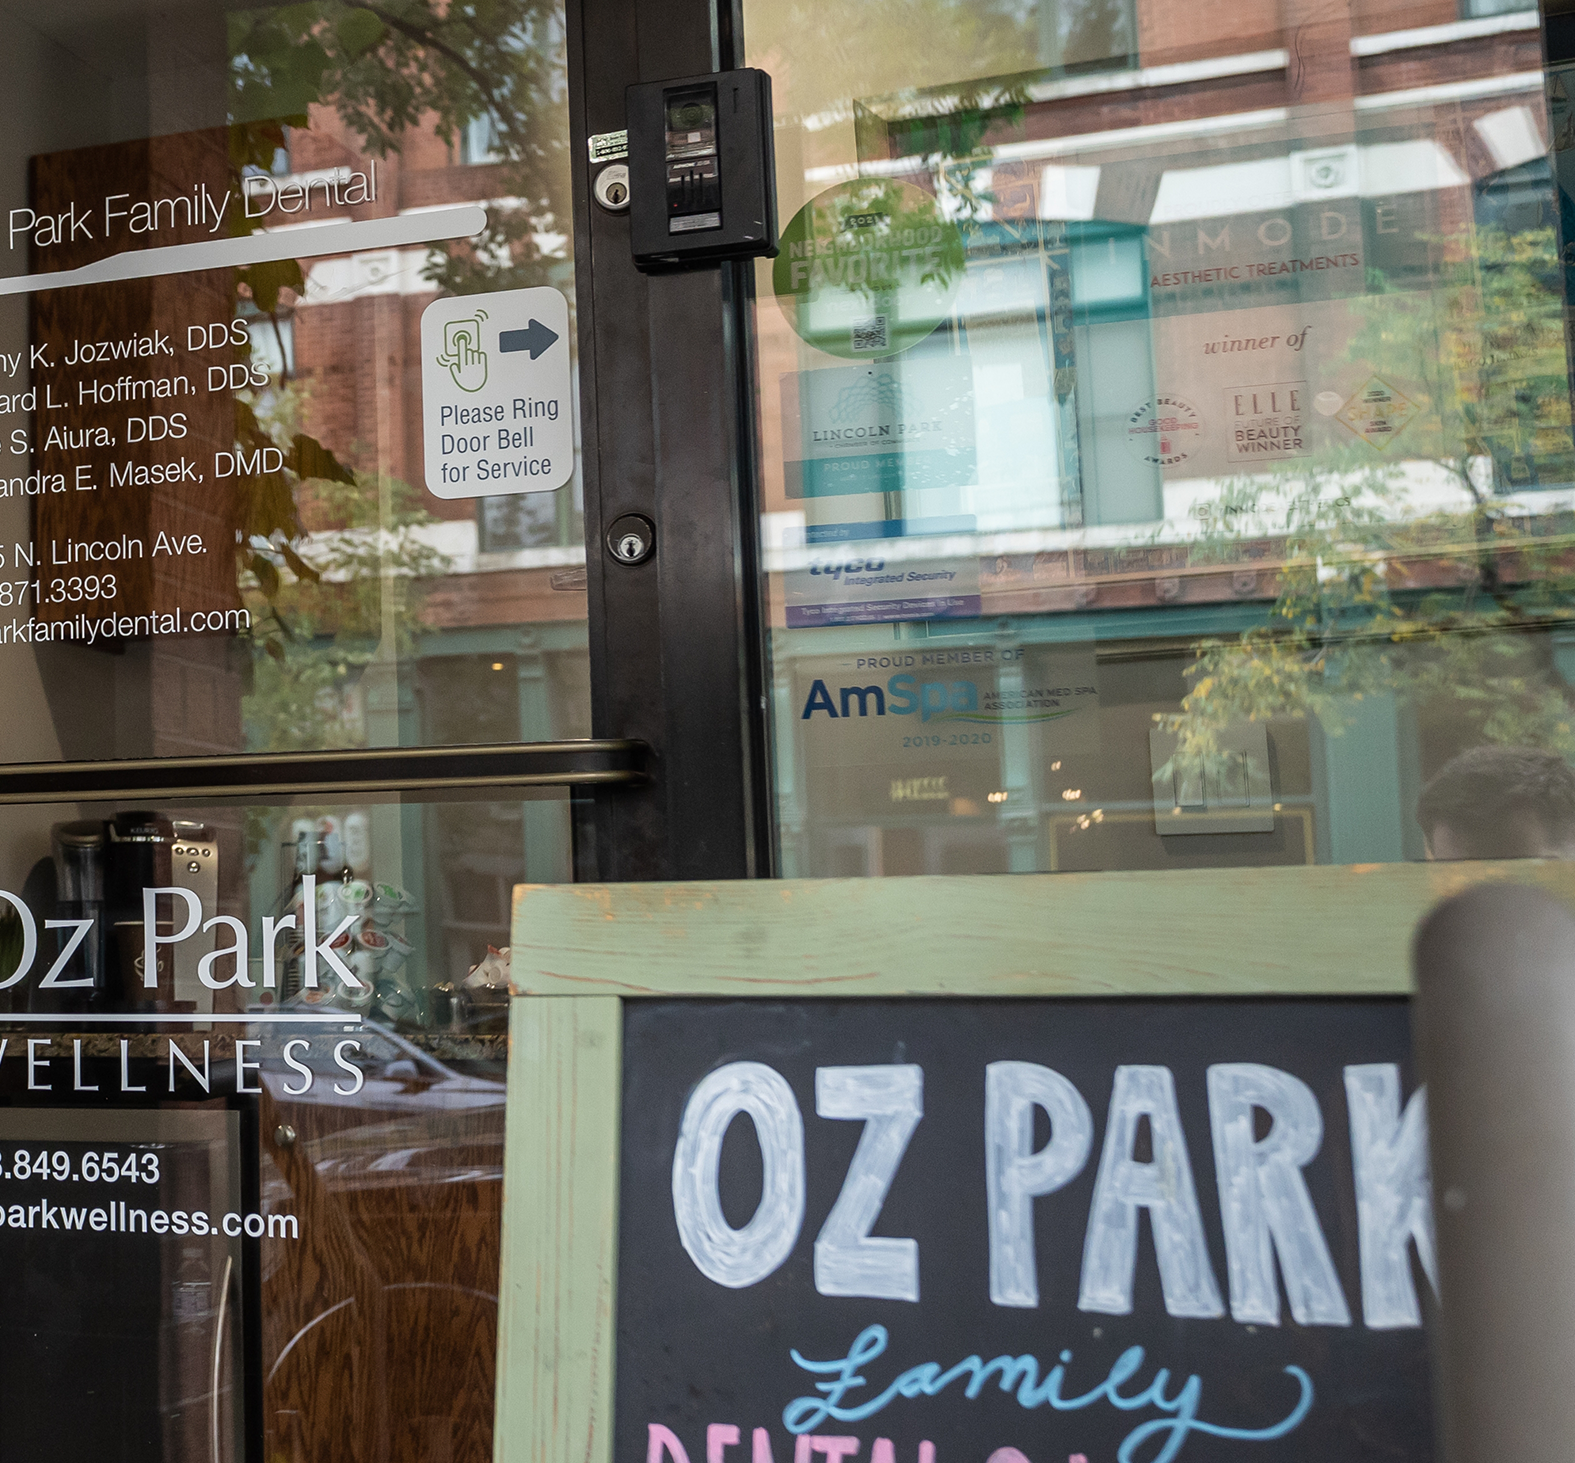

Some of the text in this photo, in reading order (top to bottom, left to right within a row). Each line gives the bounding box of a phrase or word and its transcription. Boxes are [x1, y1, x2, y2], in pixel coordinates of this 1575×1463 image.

[9, 205, 92, 250] Park
[105, 183, 230, 234] Family
[245, 160, 377, 219] Dental
[790, 246, 943, 290] FAVORITE
[1151, 253, 1360, 288] AESTHETIC TREATMENTS
[30, 344, 55, 369] K.
[65, 329, 174, 366] Jozwiak,
[188, 318, 249, 350] DDS
[1204, 325, 1313, 355] winner of
[46, 384, 68, 409] L.
[79, 375, 196, 405] Hoffman,
[208, 362, 271, 392] DDS
[440, 397, 559, 427] Please Ring
[1157, 398, 1196, 417] BEAUTY
[1234, 389, 1301, 416] ELLE
[10, 429, 34, 455] S.
[44, 424, 116, 451] Aiura,
[127, 413, 188, 443] DDS
[441, 426, 534, 455] Door Bell
[813, 421, 943, 442] LINCOLN PARK
[1235, 425, 1302, 442] BEAUTY
[1236, 438, 1303, 453] WINNER
[75, 466, 97, 491] E.
[110, 456, 203, 488] Masek,
[215, 448, 284, 478] DMD
[441, 456, 552, 483] for Service
[824, 460, 871, 472] PROUD
[15, 542, 41, 567] N.
[52, 534, 143, 565] Lincoln
[152, 530, 207, 557] Ave.
[844, 569, 957, 587] Integrated Security
[857, 649, 1025, 670] PROUD MEMBER OF
[801, 674, 978, 723] AmSpa
[1046, 687, 1072, 697] MED
[1074, 686, 1098, 696] SPA
[902, 733, 992, 748] 2019-2020
[142, 874, 364, 990] Park
[671, 1060, 1443, 1329] OZ PARK
[783, 1324, 1314, 1463] Family
